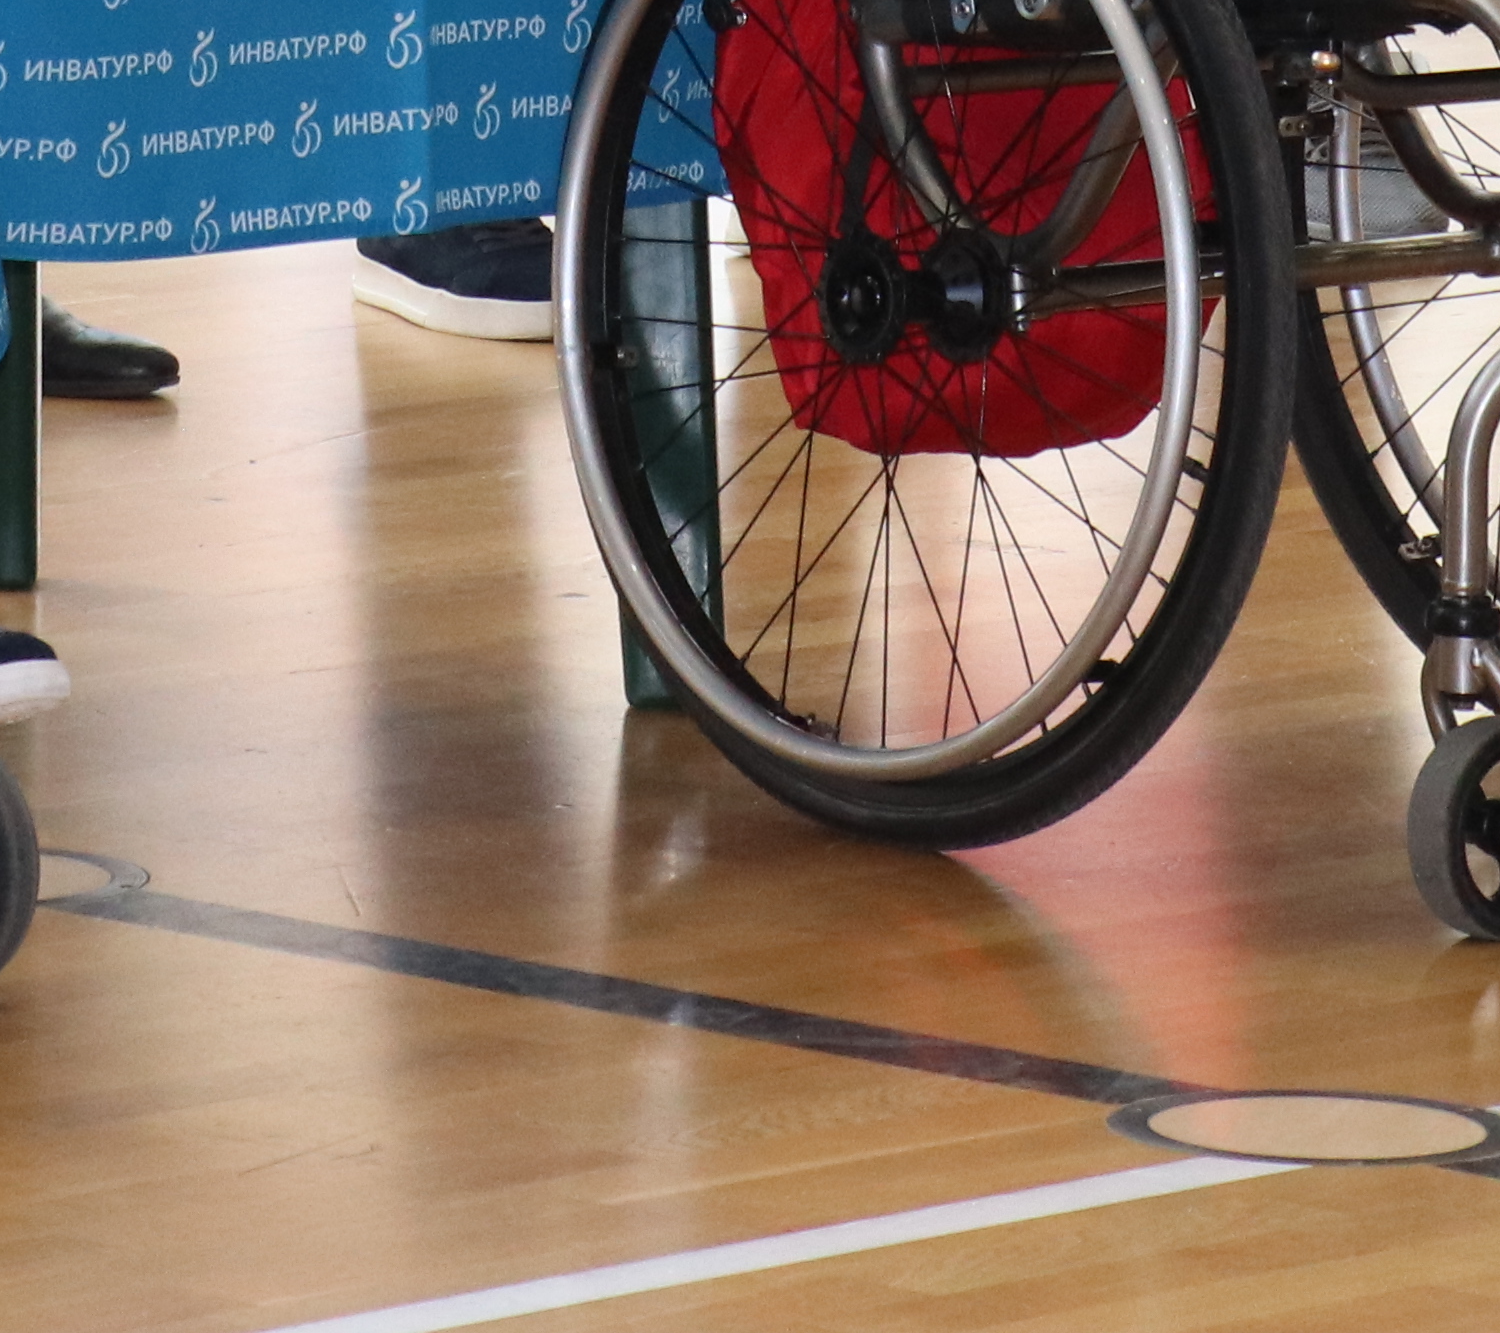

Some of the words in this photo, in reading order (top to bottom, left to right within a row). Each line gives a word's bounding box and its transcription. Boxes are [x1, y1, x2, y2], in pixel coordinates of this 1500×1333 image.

[23, 48, 174, 82] ИНВАТУР.РФ
[229, 30, 368, 66] ИНВАТУР.РФ
[142, 120, 276, 158] ИНВАТУР.РФ
[6, 217, 174, 245] ИНВАТУР.РФ
[230, 196, 373, 233] ИНВАТУР.РФ
